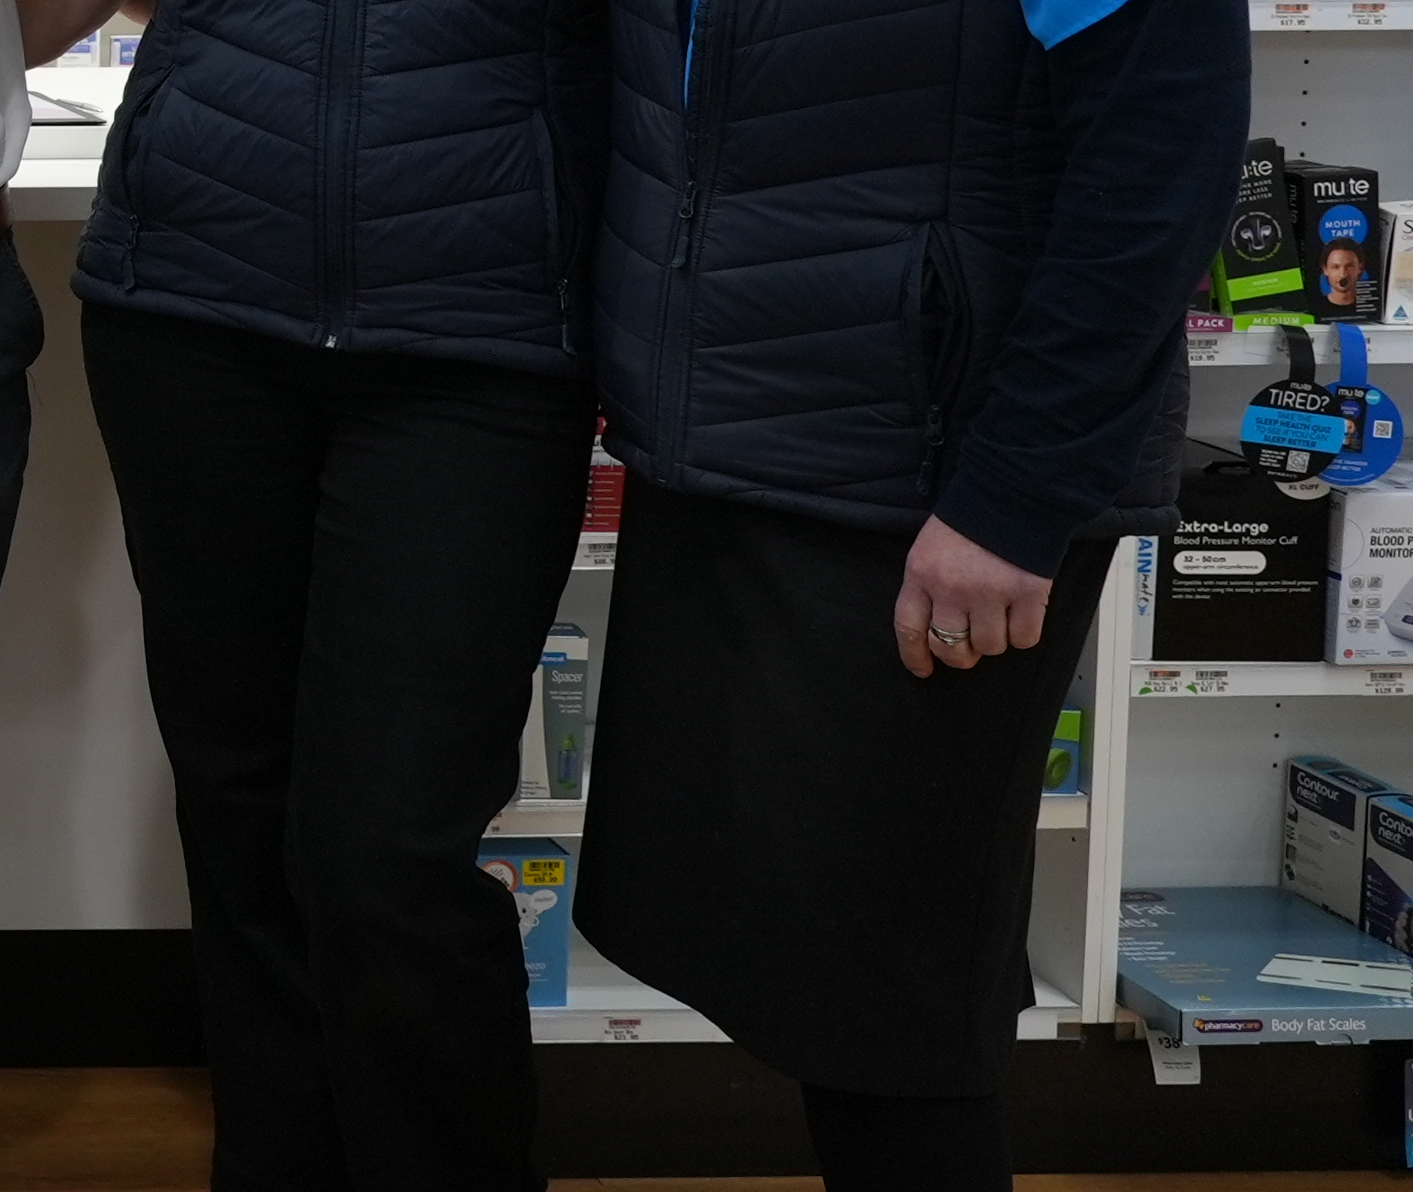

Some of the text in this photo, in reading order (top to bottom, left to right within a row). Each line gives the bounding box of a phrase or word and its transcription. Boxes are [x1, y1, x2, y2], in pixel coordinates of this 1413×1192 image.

[1324, 219, 1361, 229] MOUTH
[1330, 228, 1355, 238] TAPE
[1197, 319, 1225, 328] PACK
[1252, 317, 1300, 325] MEDIUM
[1269, 388, 1331, 412] TIRED?
[1255, 417, 1333, 434] SLEEP HEALTH QUIZ
[1288, 437, 1317, 448] BETTER
[1175, 520, 1270, 536] Extra-Large
[1174, 535, 1299, 546] Blood Pressure Monitor Cuff
[1370, 535, 1405, 546] BLOOD
[1137, 538, 1153, 574] AIN
[1183, 555, 1194, 563] 32
[551, 670, 584, 684] Spacer
[1297, 771, 1340, 802] Contour
[1296, 786, 1319, 805] next
[1378, 826, 1403, 845] next
[1204, 1020, 1260, 1031] pharmacycare
[1272, 1017, 1367, 1033] Body Fat Scales
